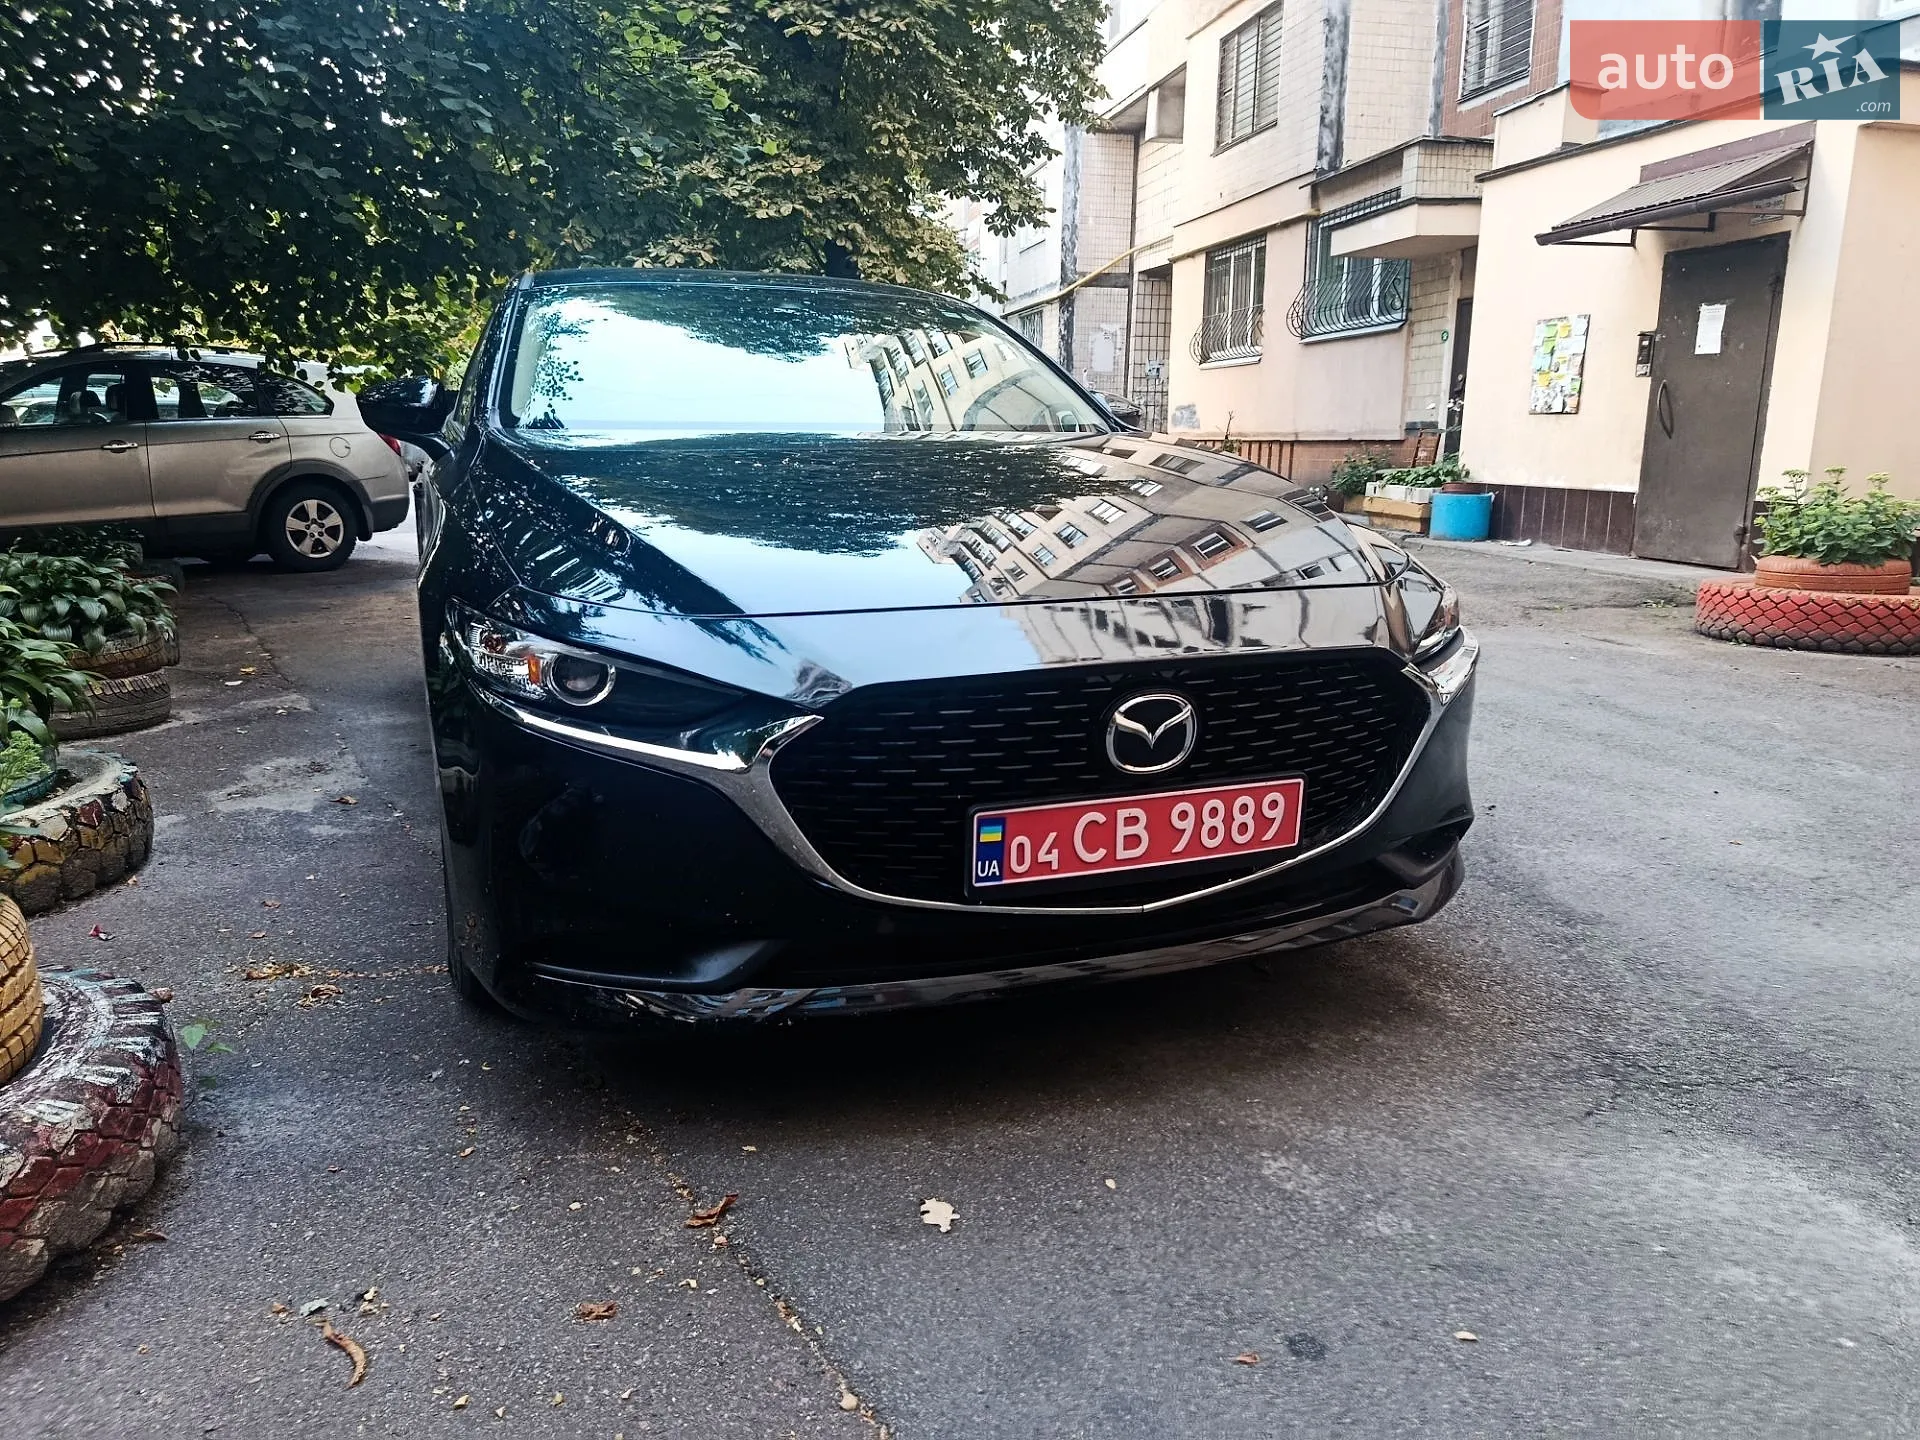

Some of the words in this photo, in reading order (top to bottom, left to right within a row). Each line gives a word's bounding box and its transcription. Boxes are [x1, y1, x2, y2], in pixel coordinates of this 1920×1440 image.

[1009, 831, 1060, 874] 04
[1072, 808, 1150, 863] CB
[1169, 792, 1286, 854] 9889
[976, 859, 1000, 878] UA
